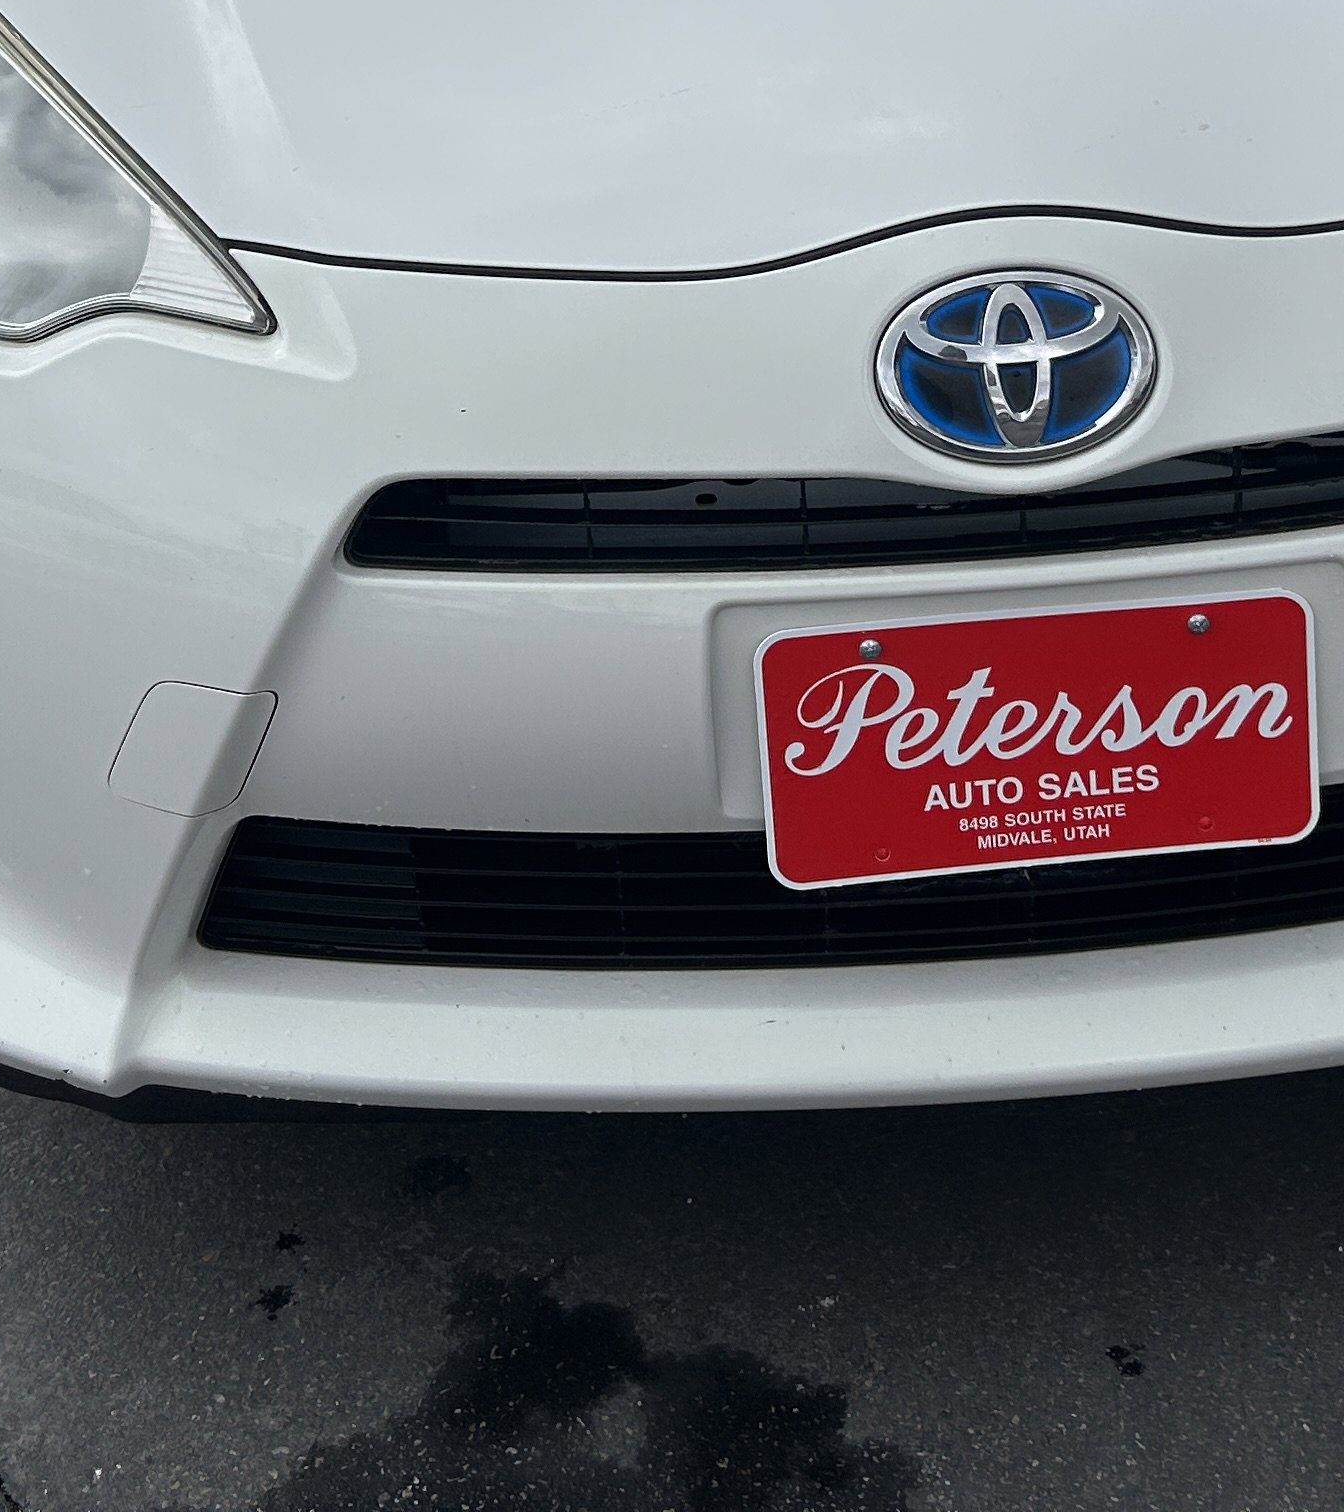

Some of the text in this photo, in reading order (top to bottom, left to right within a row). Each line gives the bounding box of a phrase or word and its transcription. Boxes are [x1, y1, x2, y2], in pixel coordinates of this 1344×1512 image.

[784, 662, 1293, 777] Peterson
[923, 764, 1160, 812] AUTO SALES
[959, 803, 1127, 832] 8498 SOUTH STATE
[977, 824, 1110, 851] MIDVALE, UTAH
